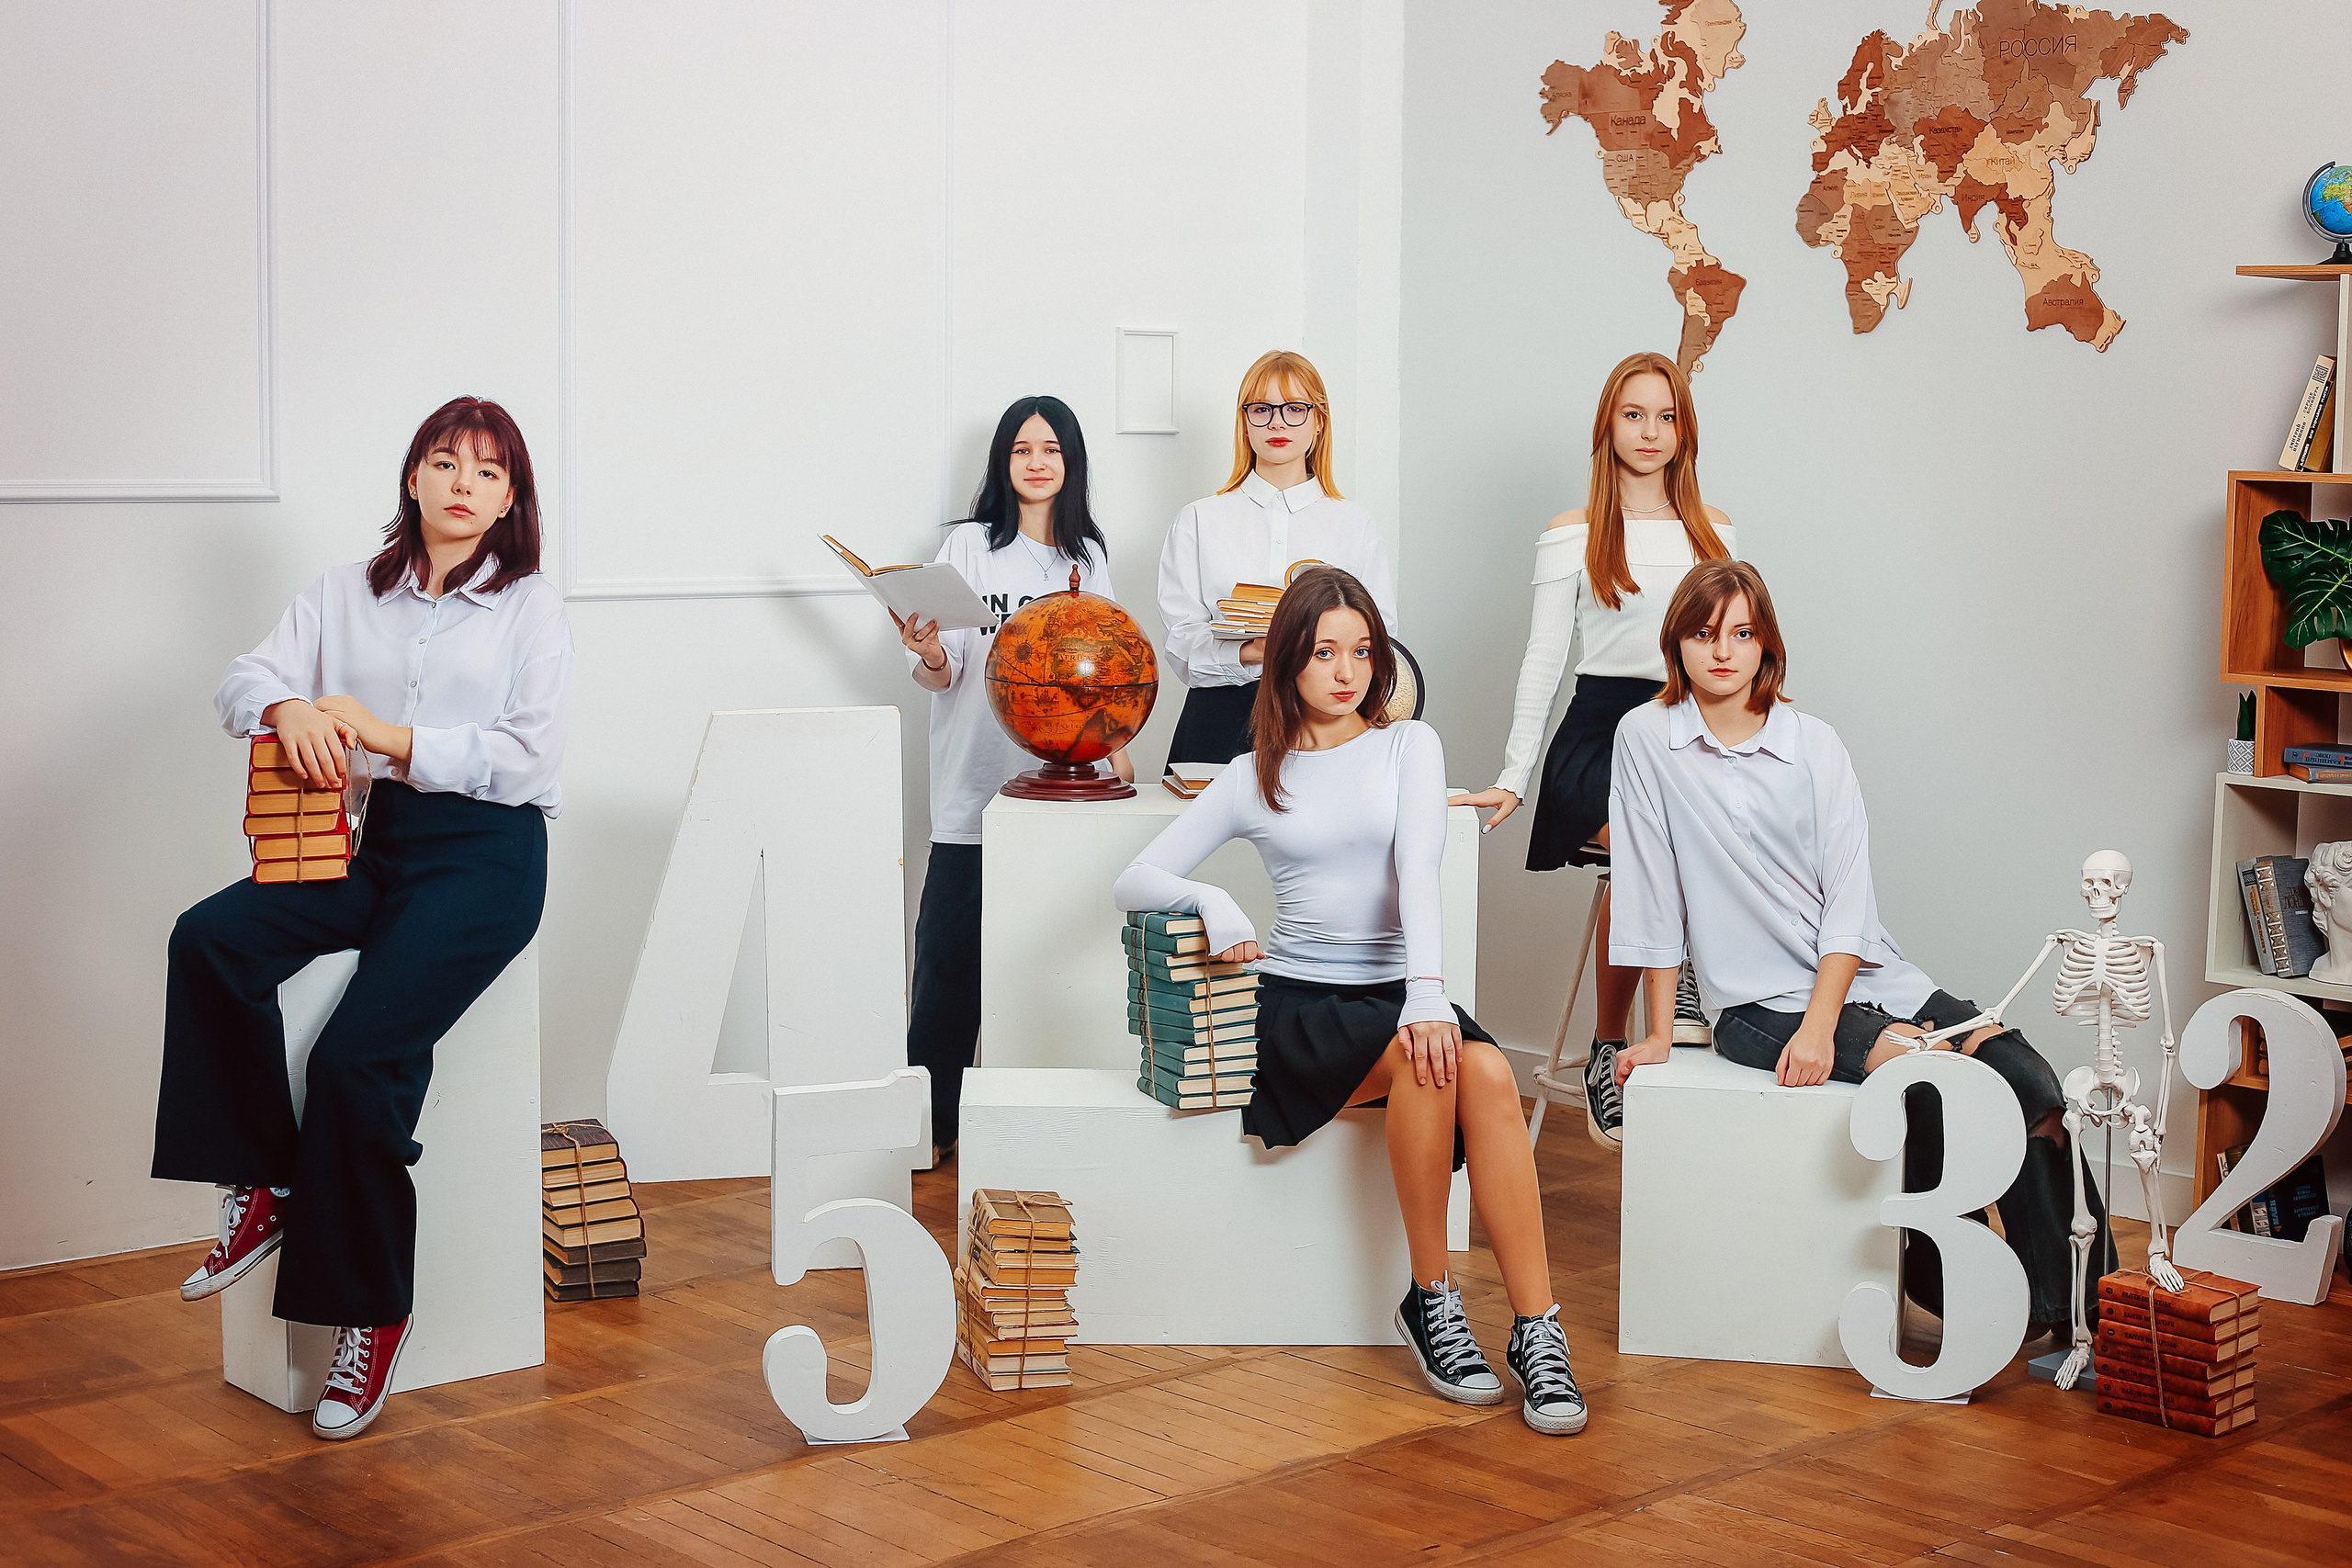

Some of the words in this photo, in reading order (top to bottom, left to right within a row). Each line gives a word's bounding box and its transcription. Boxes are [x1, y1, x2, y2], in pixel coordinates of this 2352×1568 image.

[1999, 35, 2077, 58] РОССИЯ
[1611, 115, 1646, 127] Канада
[1929, 126, 1962, 134] Казахстан
[1617, 153, 1634, 163] США
[1991, 156, 2016, 166] Китай
[1962, 194, 1984, 202] Индия
[2043, 298, 2084, 307] Австралия
[2172, 987, 2346, 1305] 2
[1838, 1050, 2030, 1400] 3
[763, 1067, 957, 1441] 5
